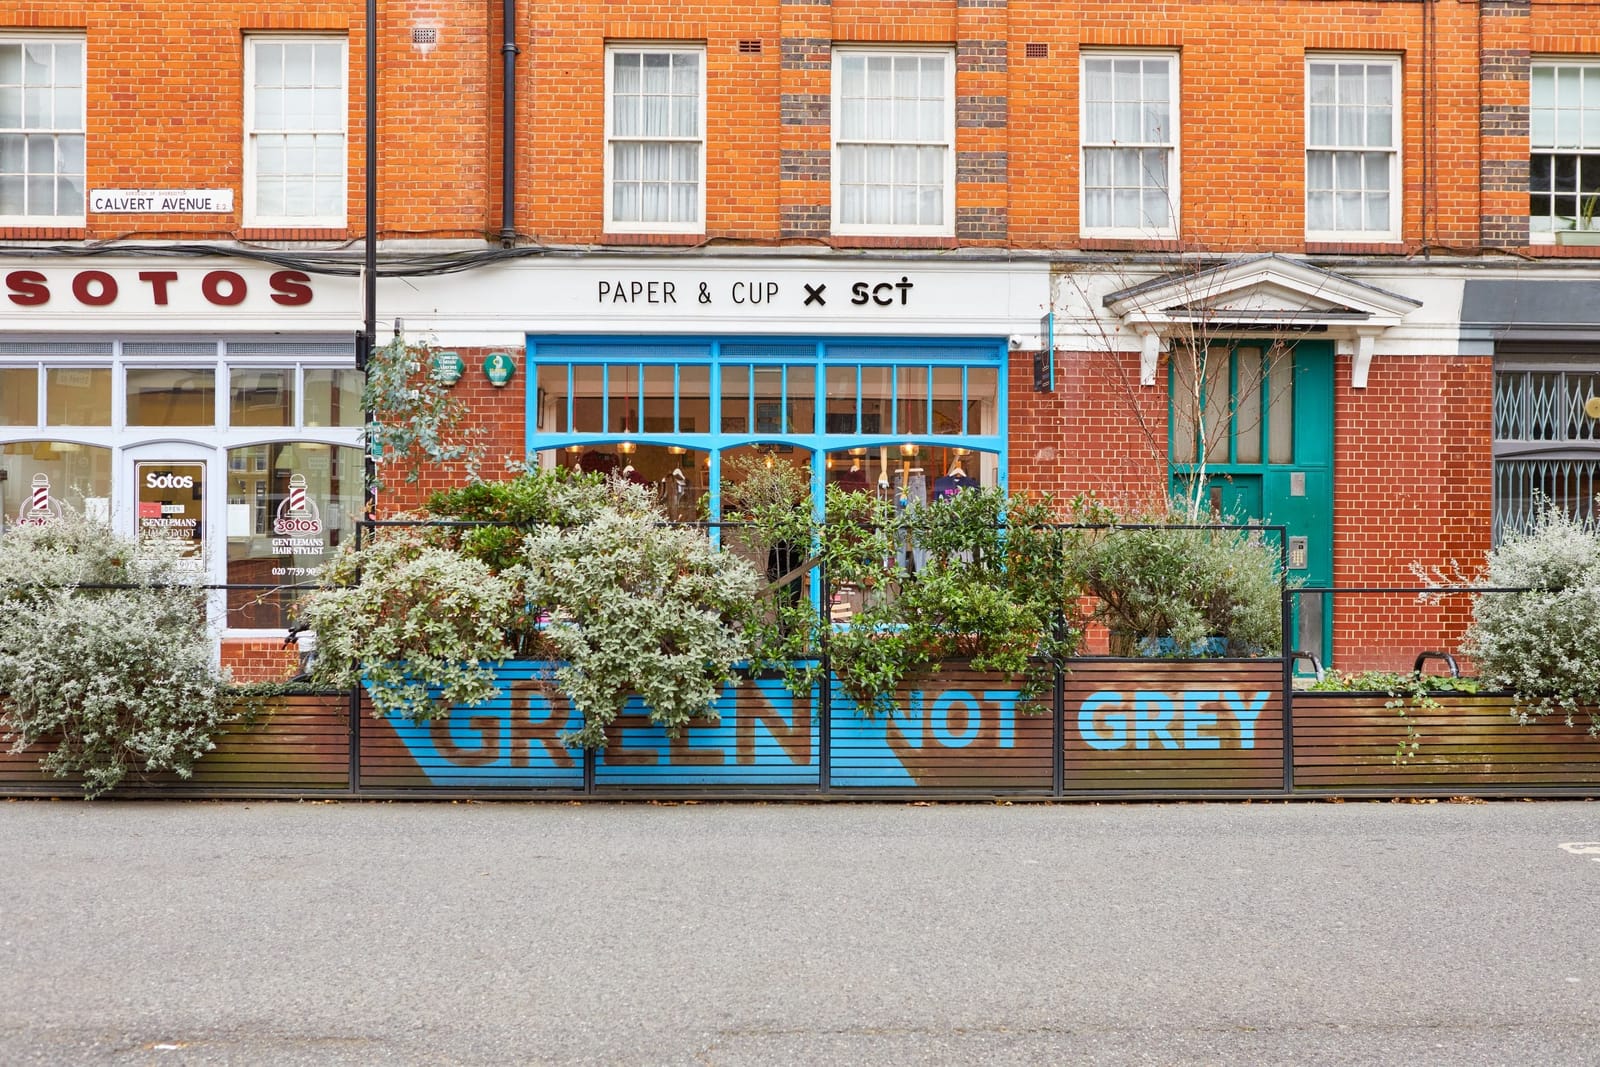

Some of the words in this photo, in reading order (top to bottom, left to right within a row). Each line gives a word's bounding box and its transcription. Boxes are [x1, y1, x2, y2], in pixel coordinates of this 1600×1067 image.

[95, 198, 154, 210] CALVERT
[161, 198, 212, 210] AVENUE
[5, 270, 314, 306] SOTOS
[598, 281, 677, 304] PAPER
[698, 281, 712, 304] &
[732, 281, 779, 304] CUP
[146, 472, 193, 489] Sotos
[272, 538, 324, 546] GENTLEMANS
[272, 547, 292, 555] HAIR
[293, 547, 324, 555] STYLIST
[271, 567, 286, 575] 020
[287, 567, 305, 576] 7739
[430, 680, 812, 767] GREEN
[872, 690, 1028, 750] NOT
[1078, 690, 1271, 751] GREY
